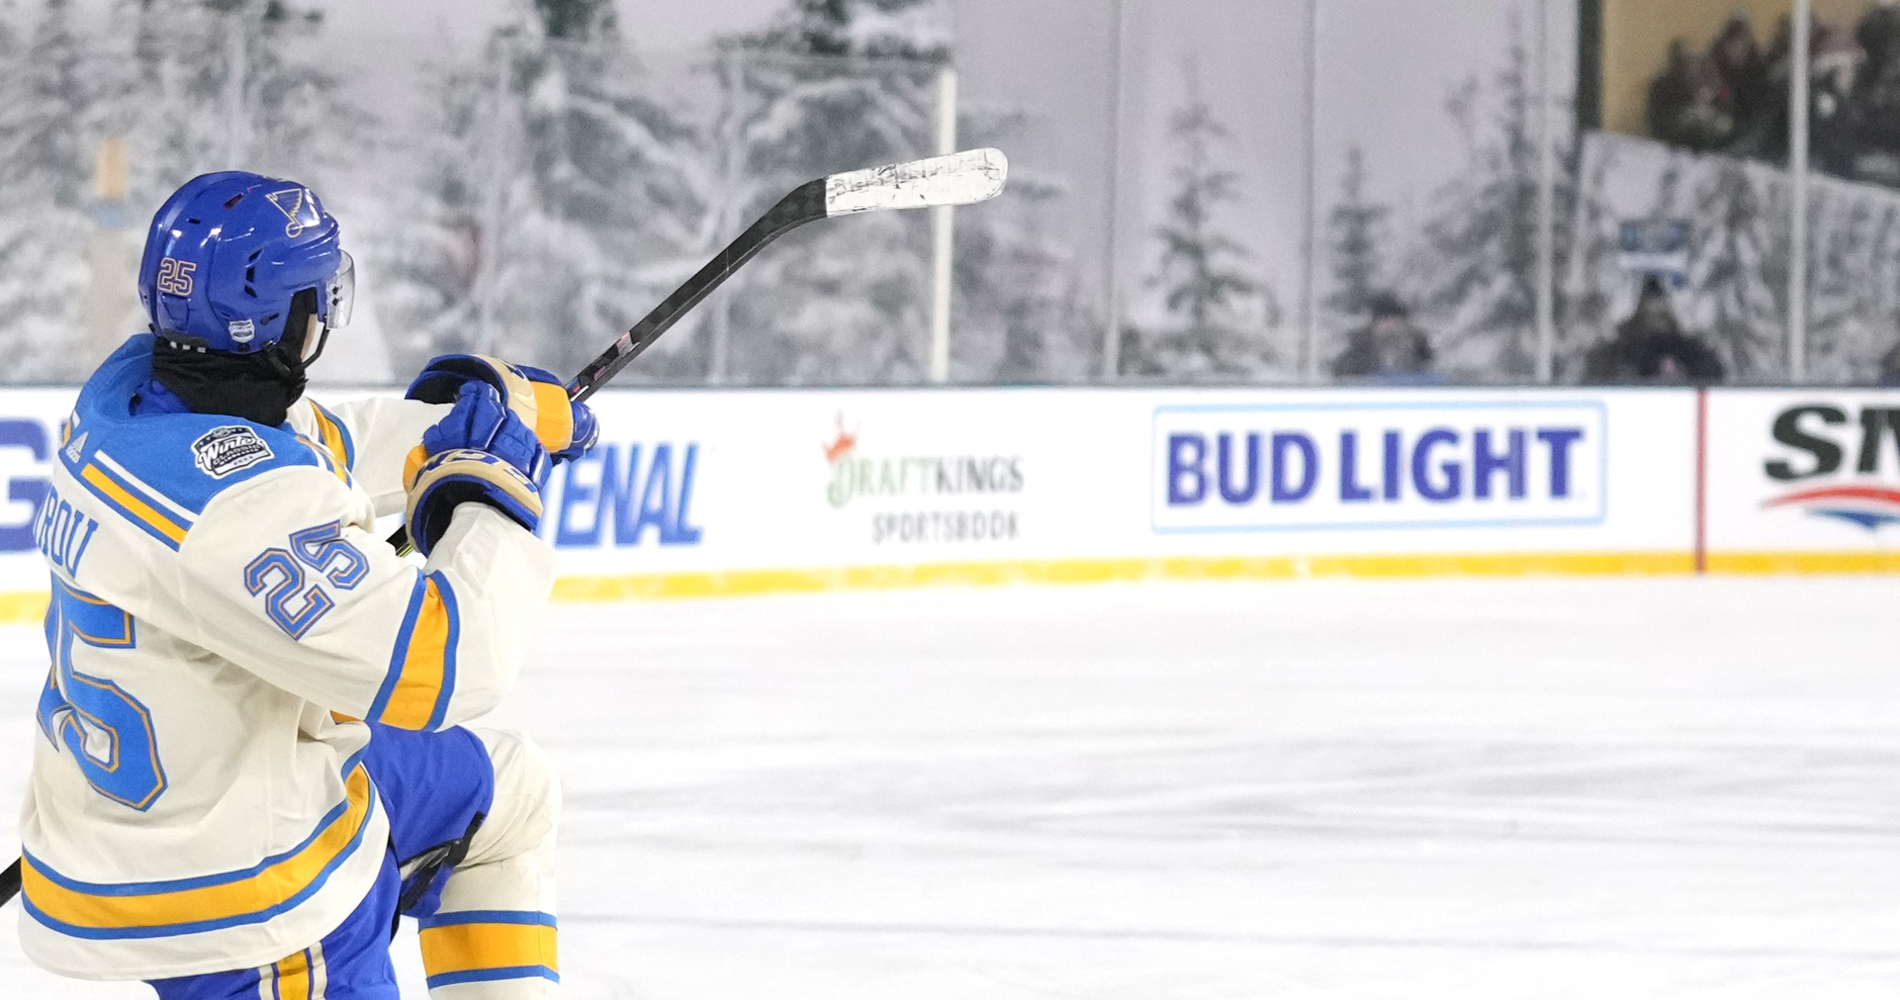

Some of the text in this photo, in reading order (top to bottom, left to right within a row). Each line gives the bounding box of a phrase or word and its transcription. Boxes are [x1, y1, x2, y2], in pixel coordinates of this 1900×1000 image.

[156, 256, 198, 298] 25
[825, 454, 1025, 509] DRAFTKINGS
[1166, 426, 1586, 506] BUD LIGHT
[871, 509, 1020, 545] SPORTSBOOK
[244, 520, 370, 642] 25
